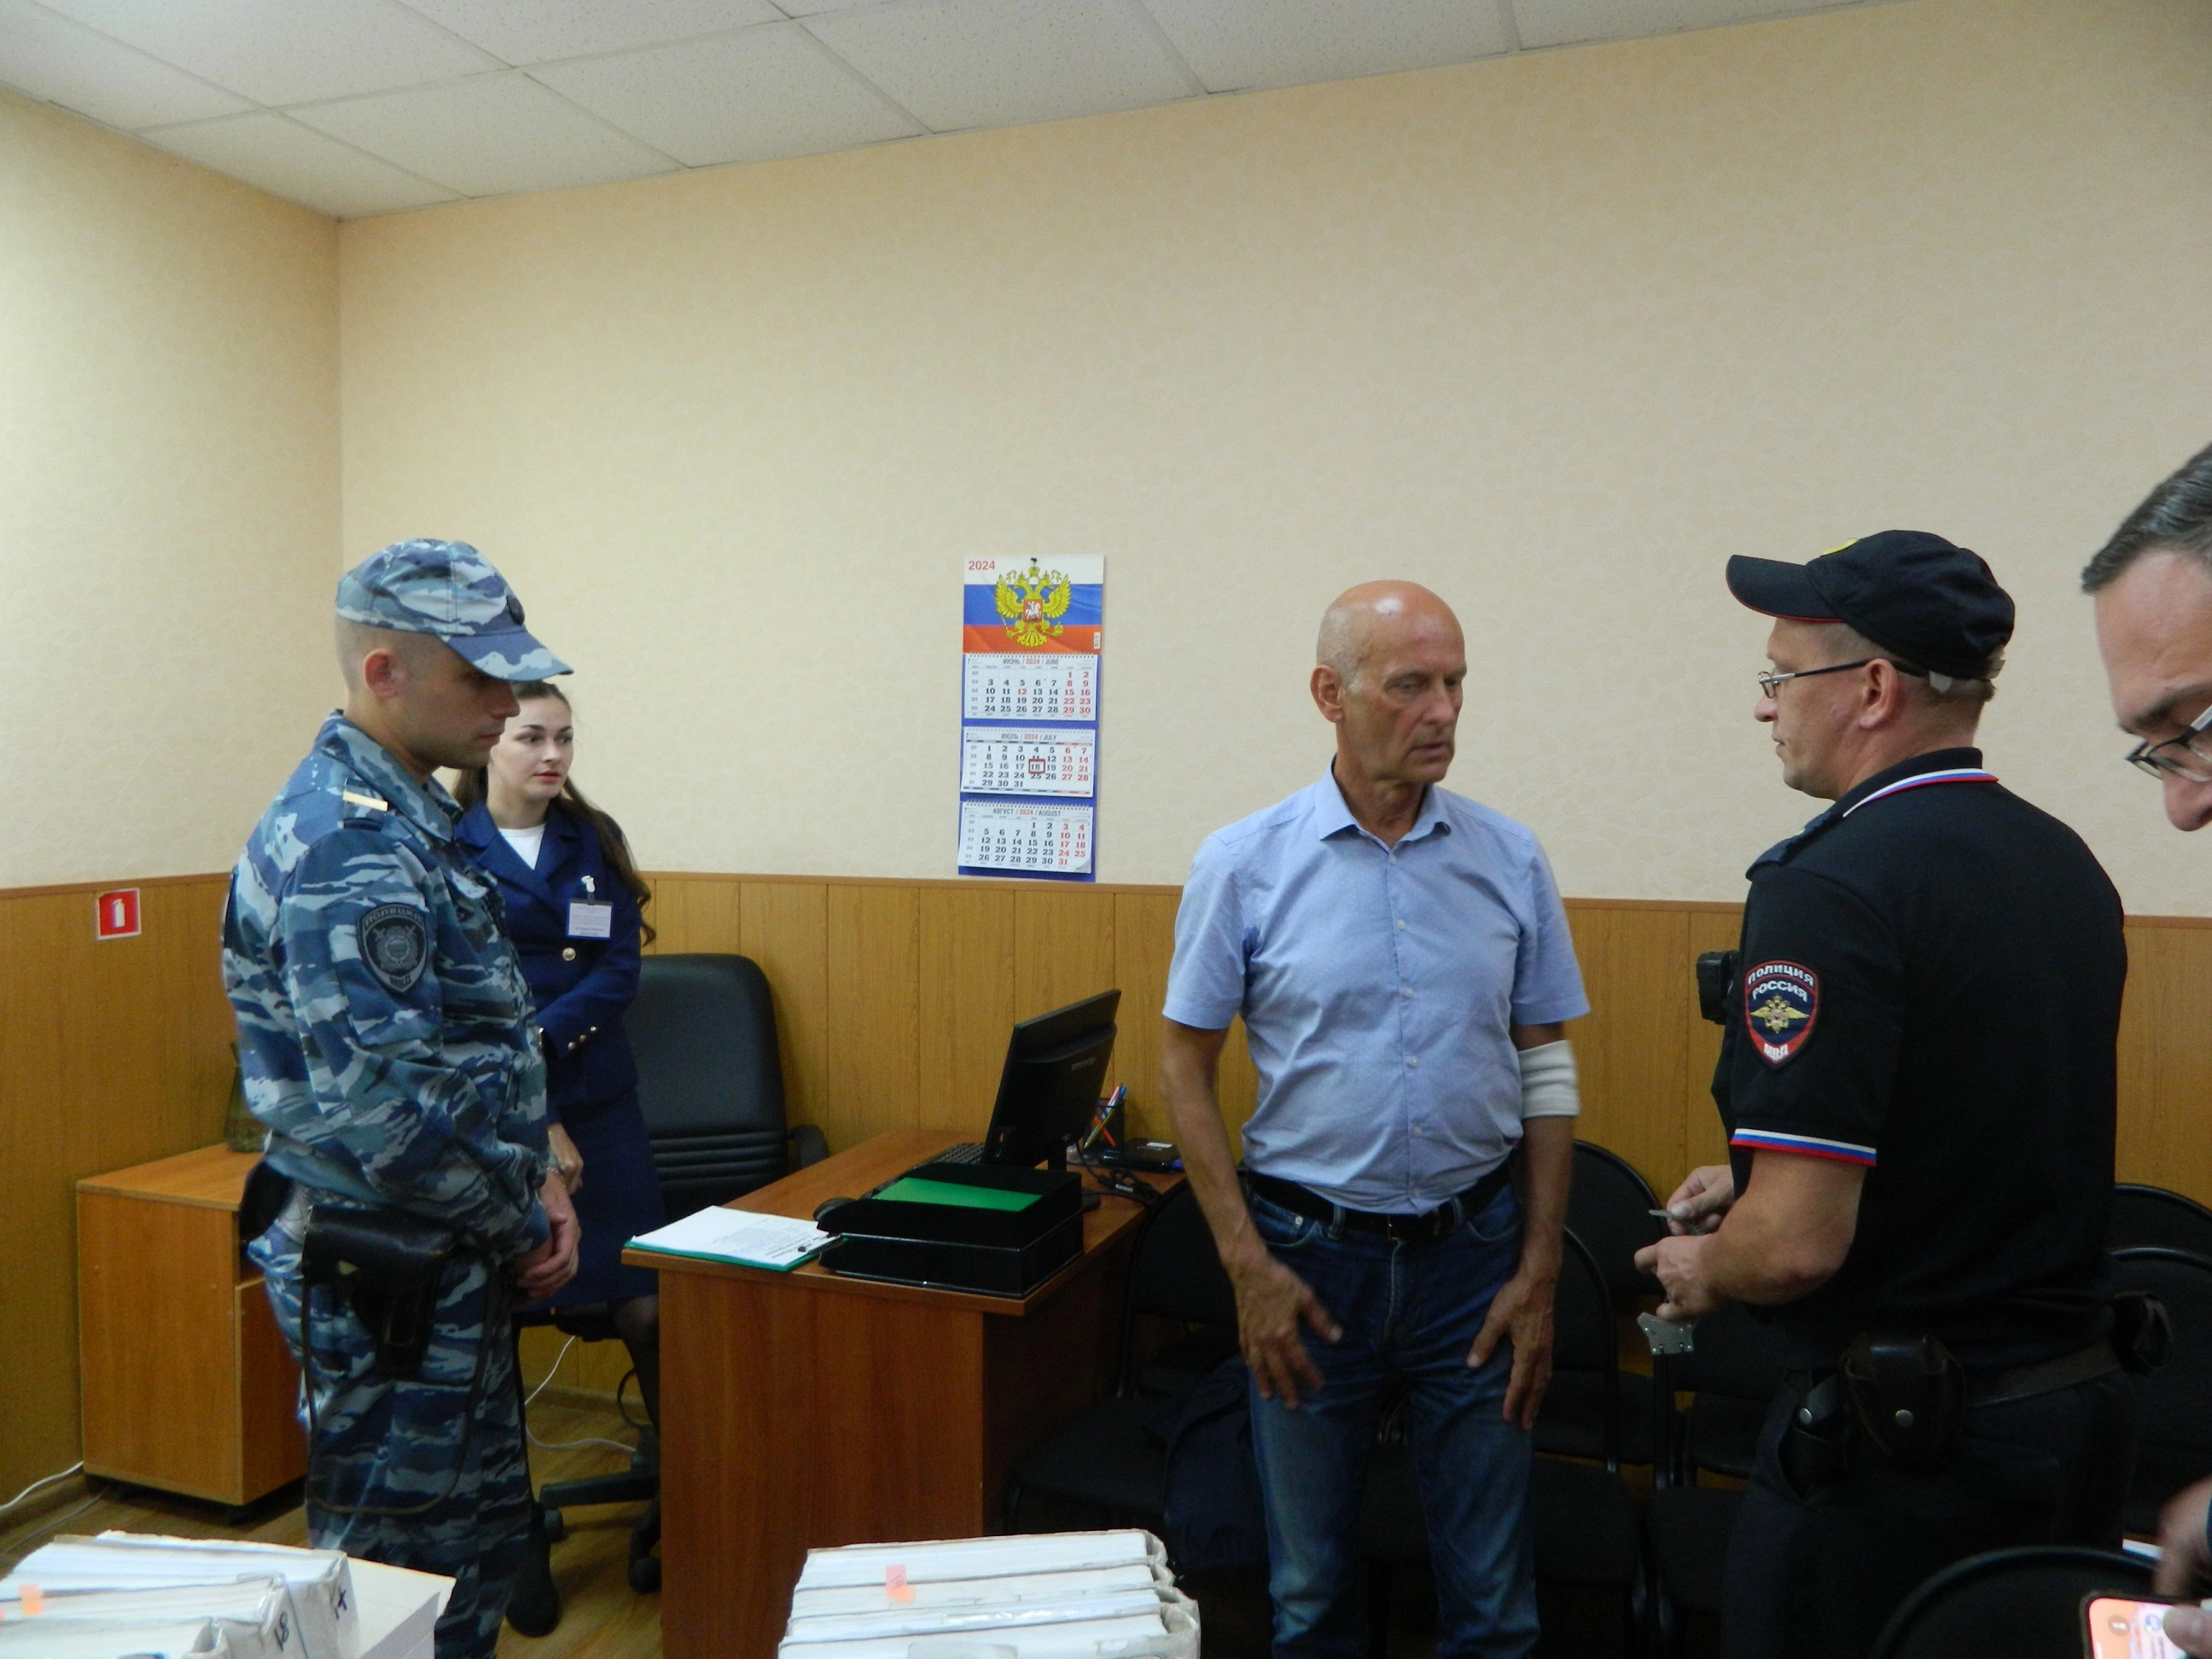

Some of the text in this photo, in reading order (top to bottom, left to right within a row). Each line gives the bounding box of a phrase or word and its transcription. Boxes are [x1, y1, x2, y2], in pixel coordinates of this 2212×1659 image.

[969, 560, 996, 570] 2024
[1748, 964, 1813, 987] ПОЛИЦИЯ
[1752, 981, 1807, 1002] РОССИЯ
[1763, 1042, 1790, 1061] МВД
